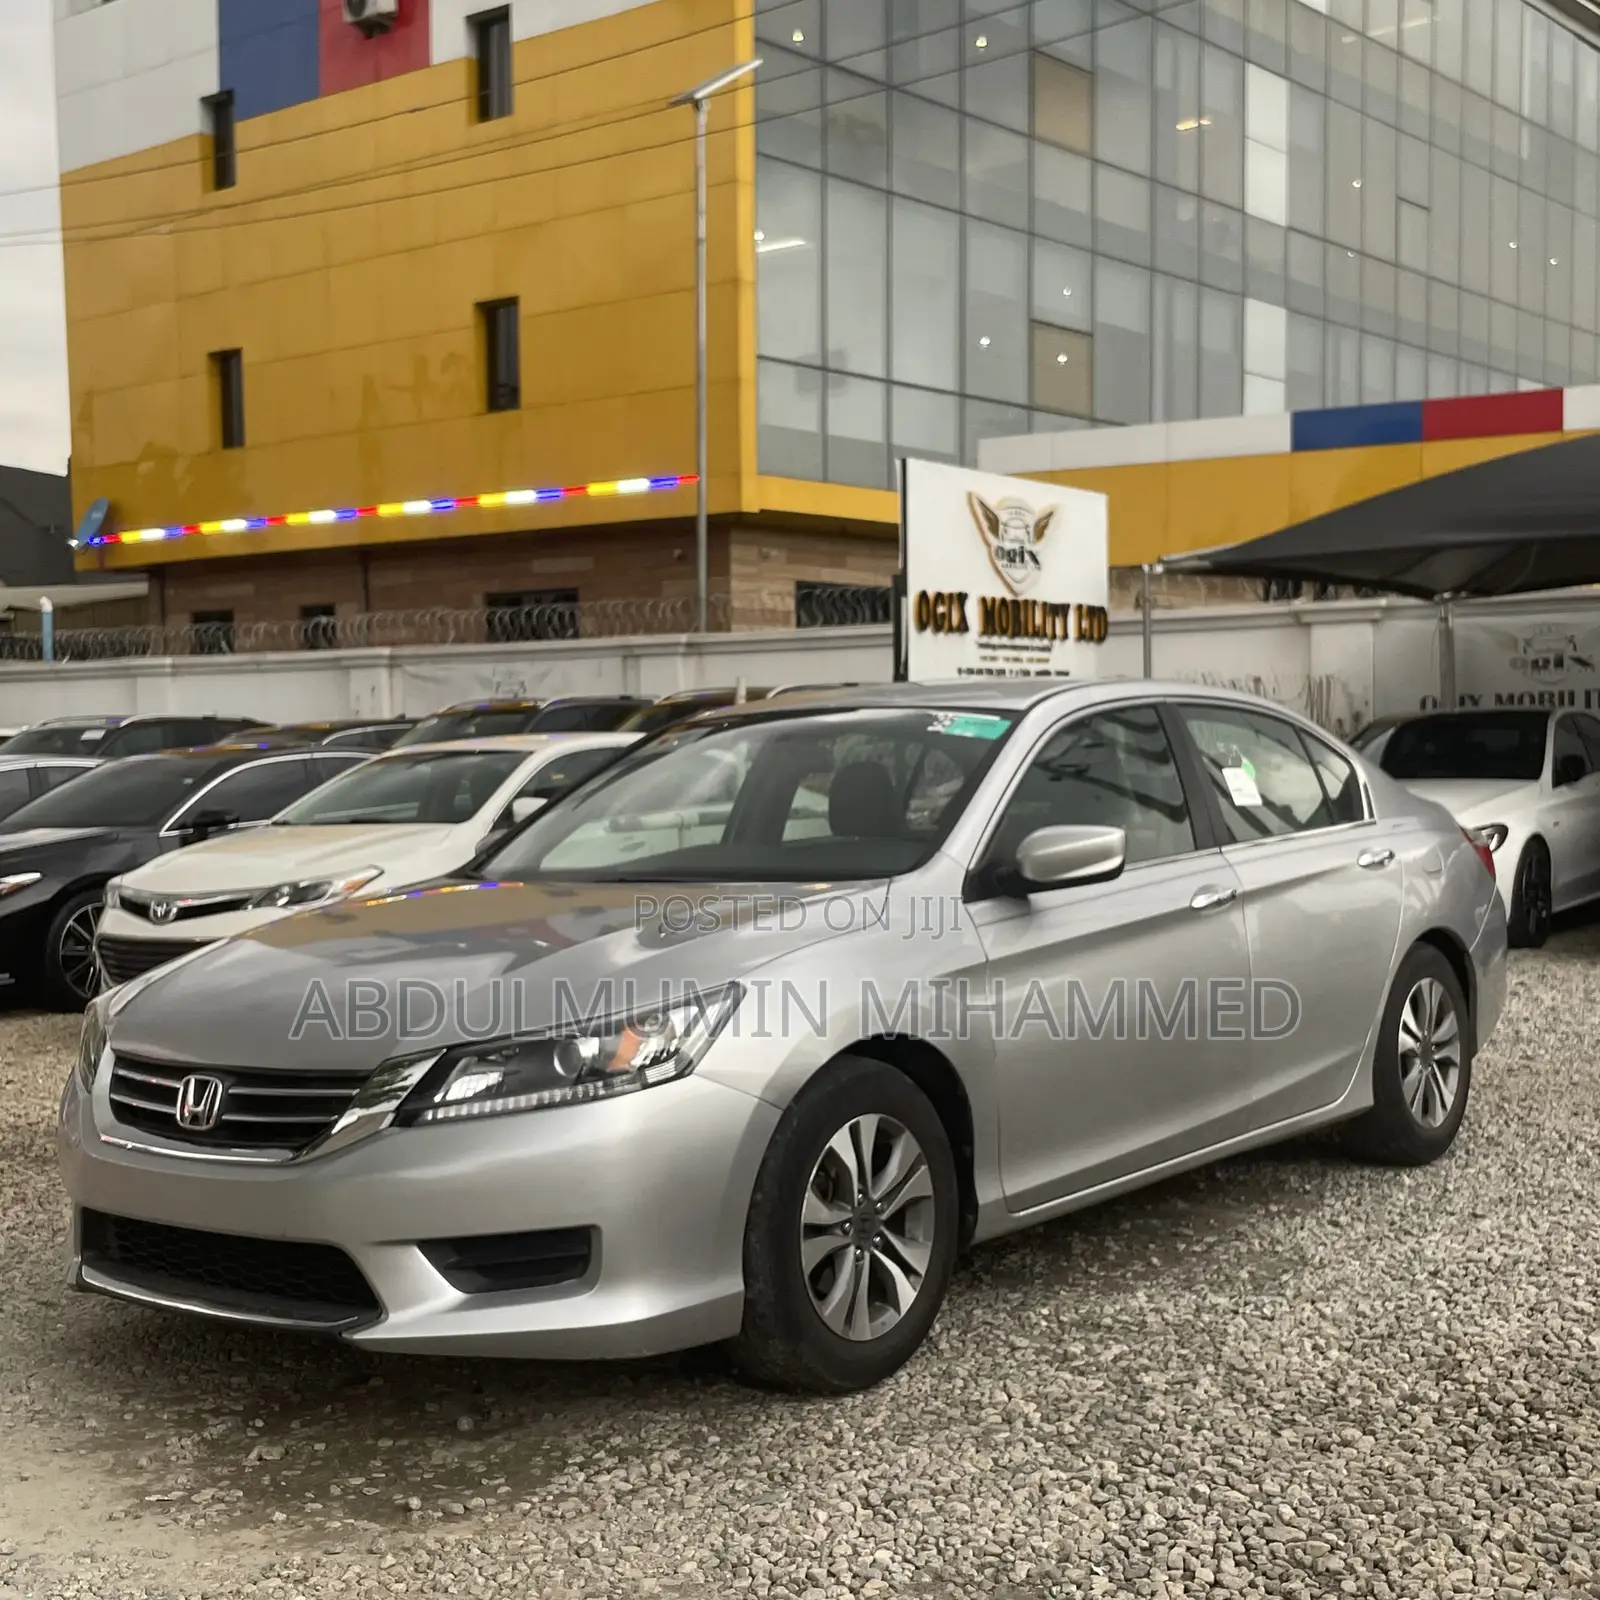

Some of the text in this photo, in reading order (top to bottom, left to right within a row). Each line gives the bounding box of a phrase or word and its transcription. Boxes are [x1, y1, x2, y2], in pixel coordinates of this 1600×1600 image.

[913, 590, 1109, 643] OGIX MOBILITY LTD
